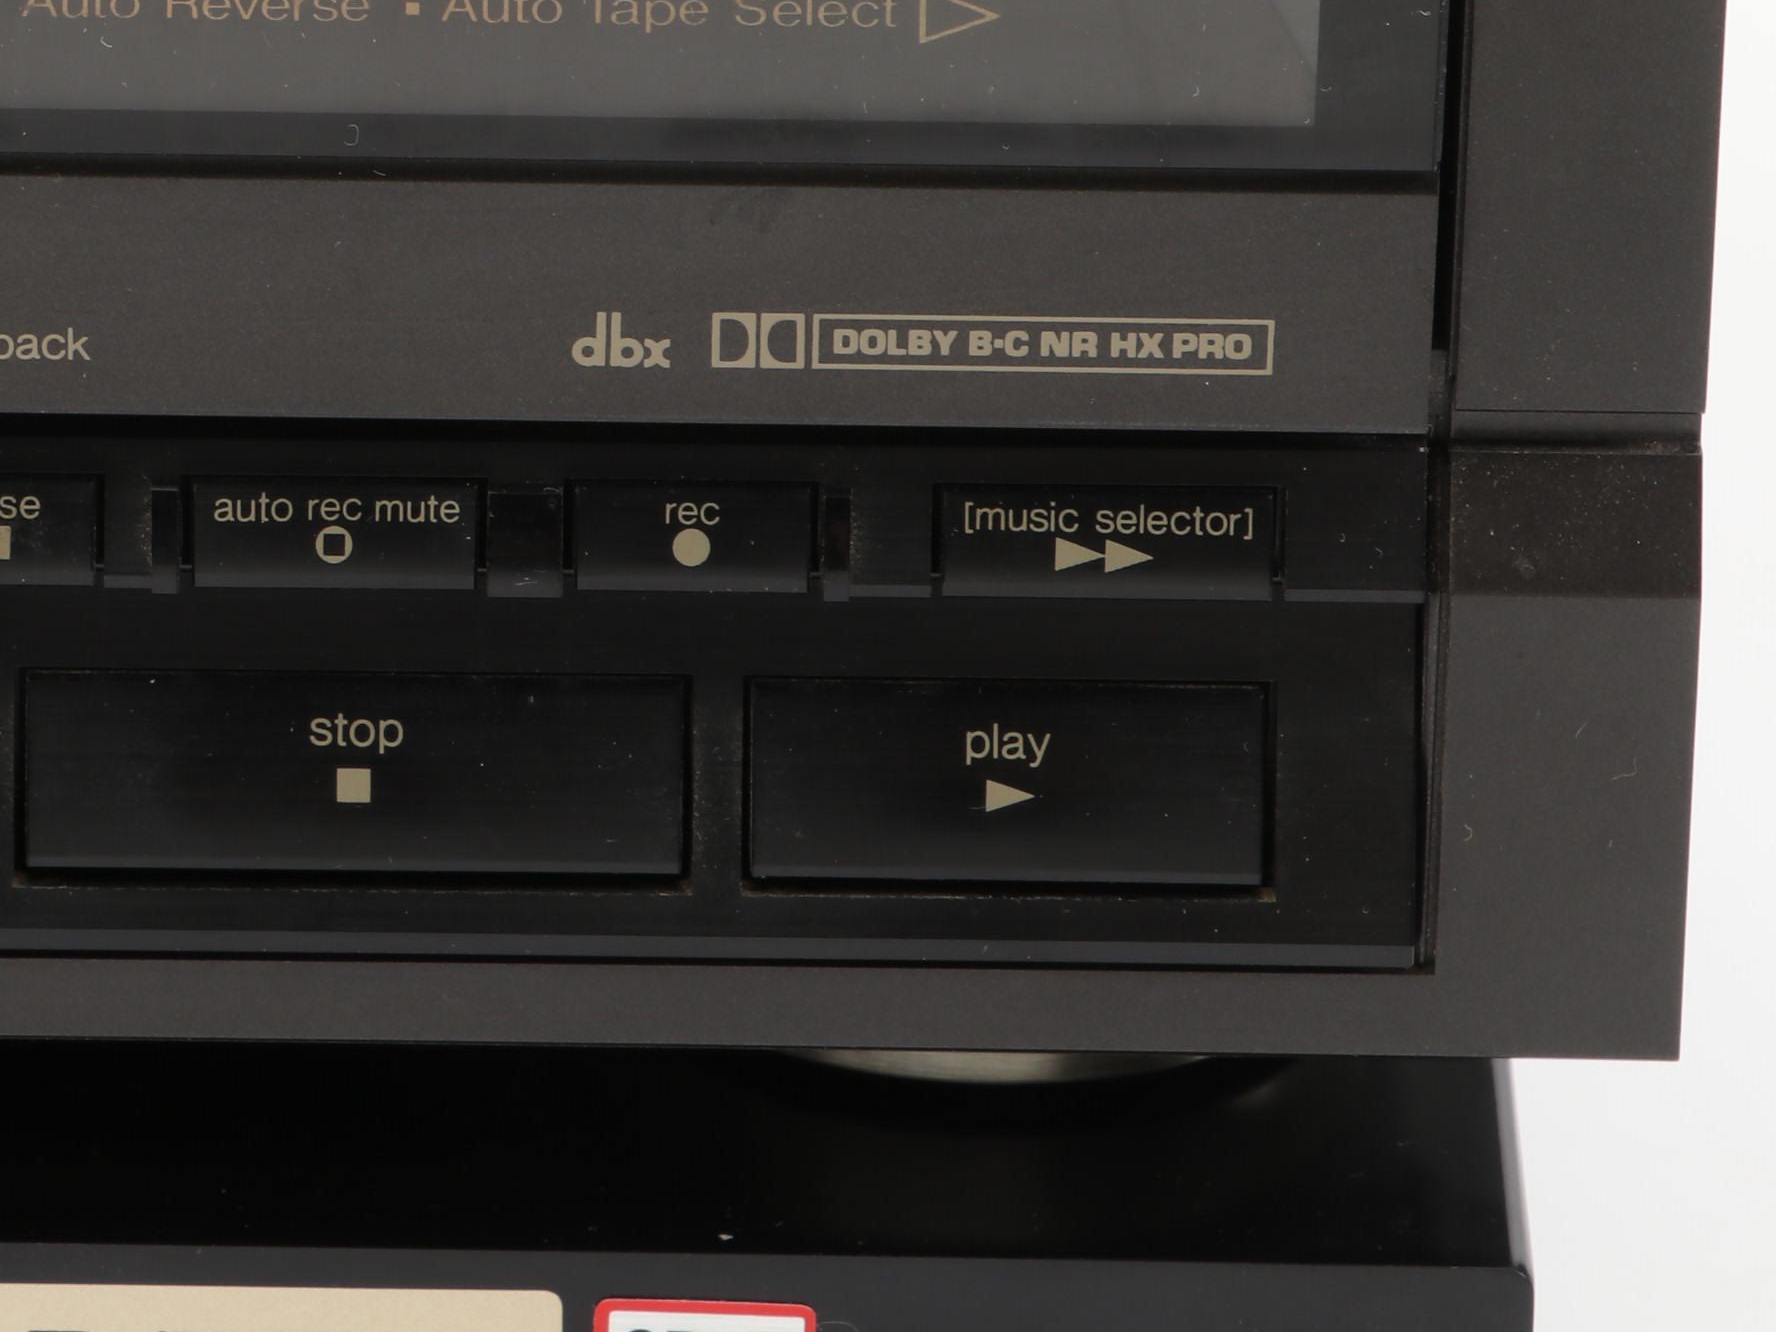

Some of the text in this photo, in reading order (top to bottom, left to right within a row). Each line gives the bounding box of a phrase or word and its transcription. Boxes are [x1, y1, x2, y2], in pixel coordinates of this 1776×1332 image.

[571, 311, 671, 369] dbx
[832, 328, 958, 356] DOLBY
[1040, 330, 1098, 358] NR
[1110, 332, 1165, 359] HX
[1172, 332, 1252, 360] PRO
[213, 491, 461, 524] auto rec mute
[665, 502, 720, 526] rec
[964, 501, 1253, 539] [music selector]
[309, 713, 404, 755] stop
[965, 723, 1051, 768] play
